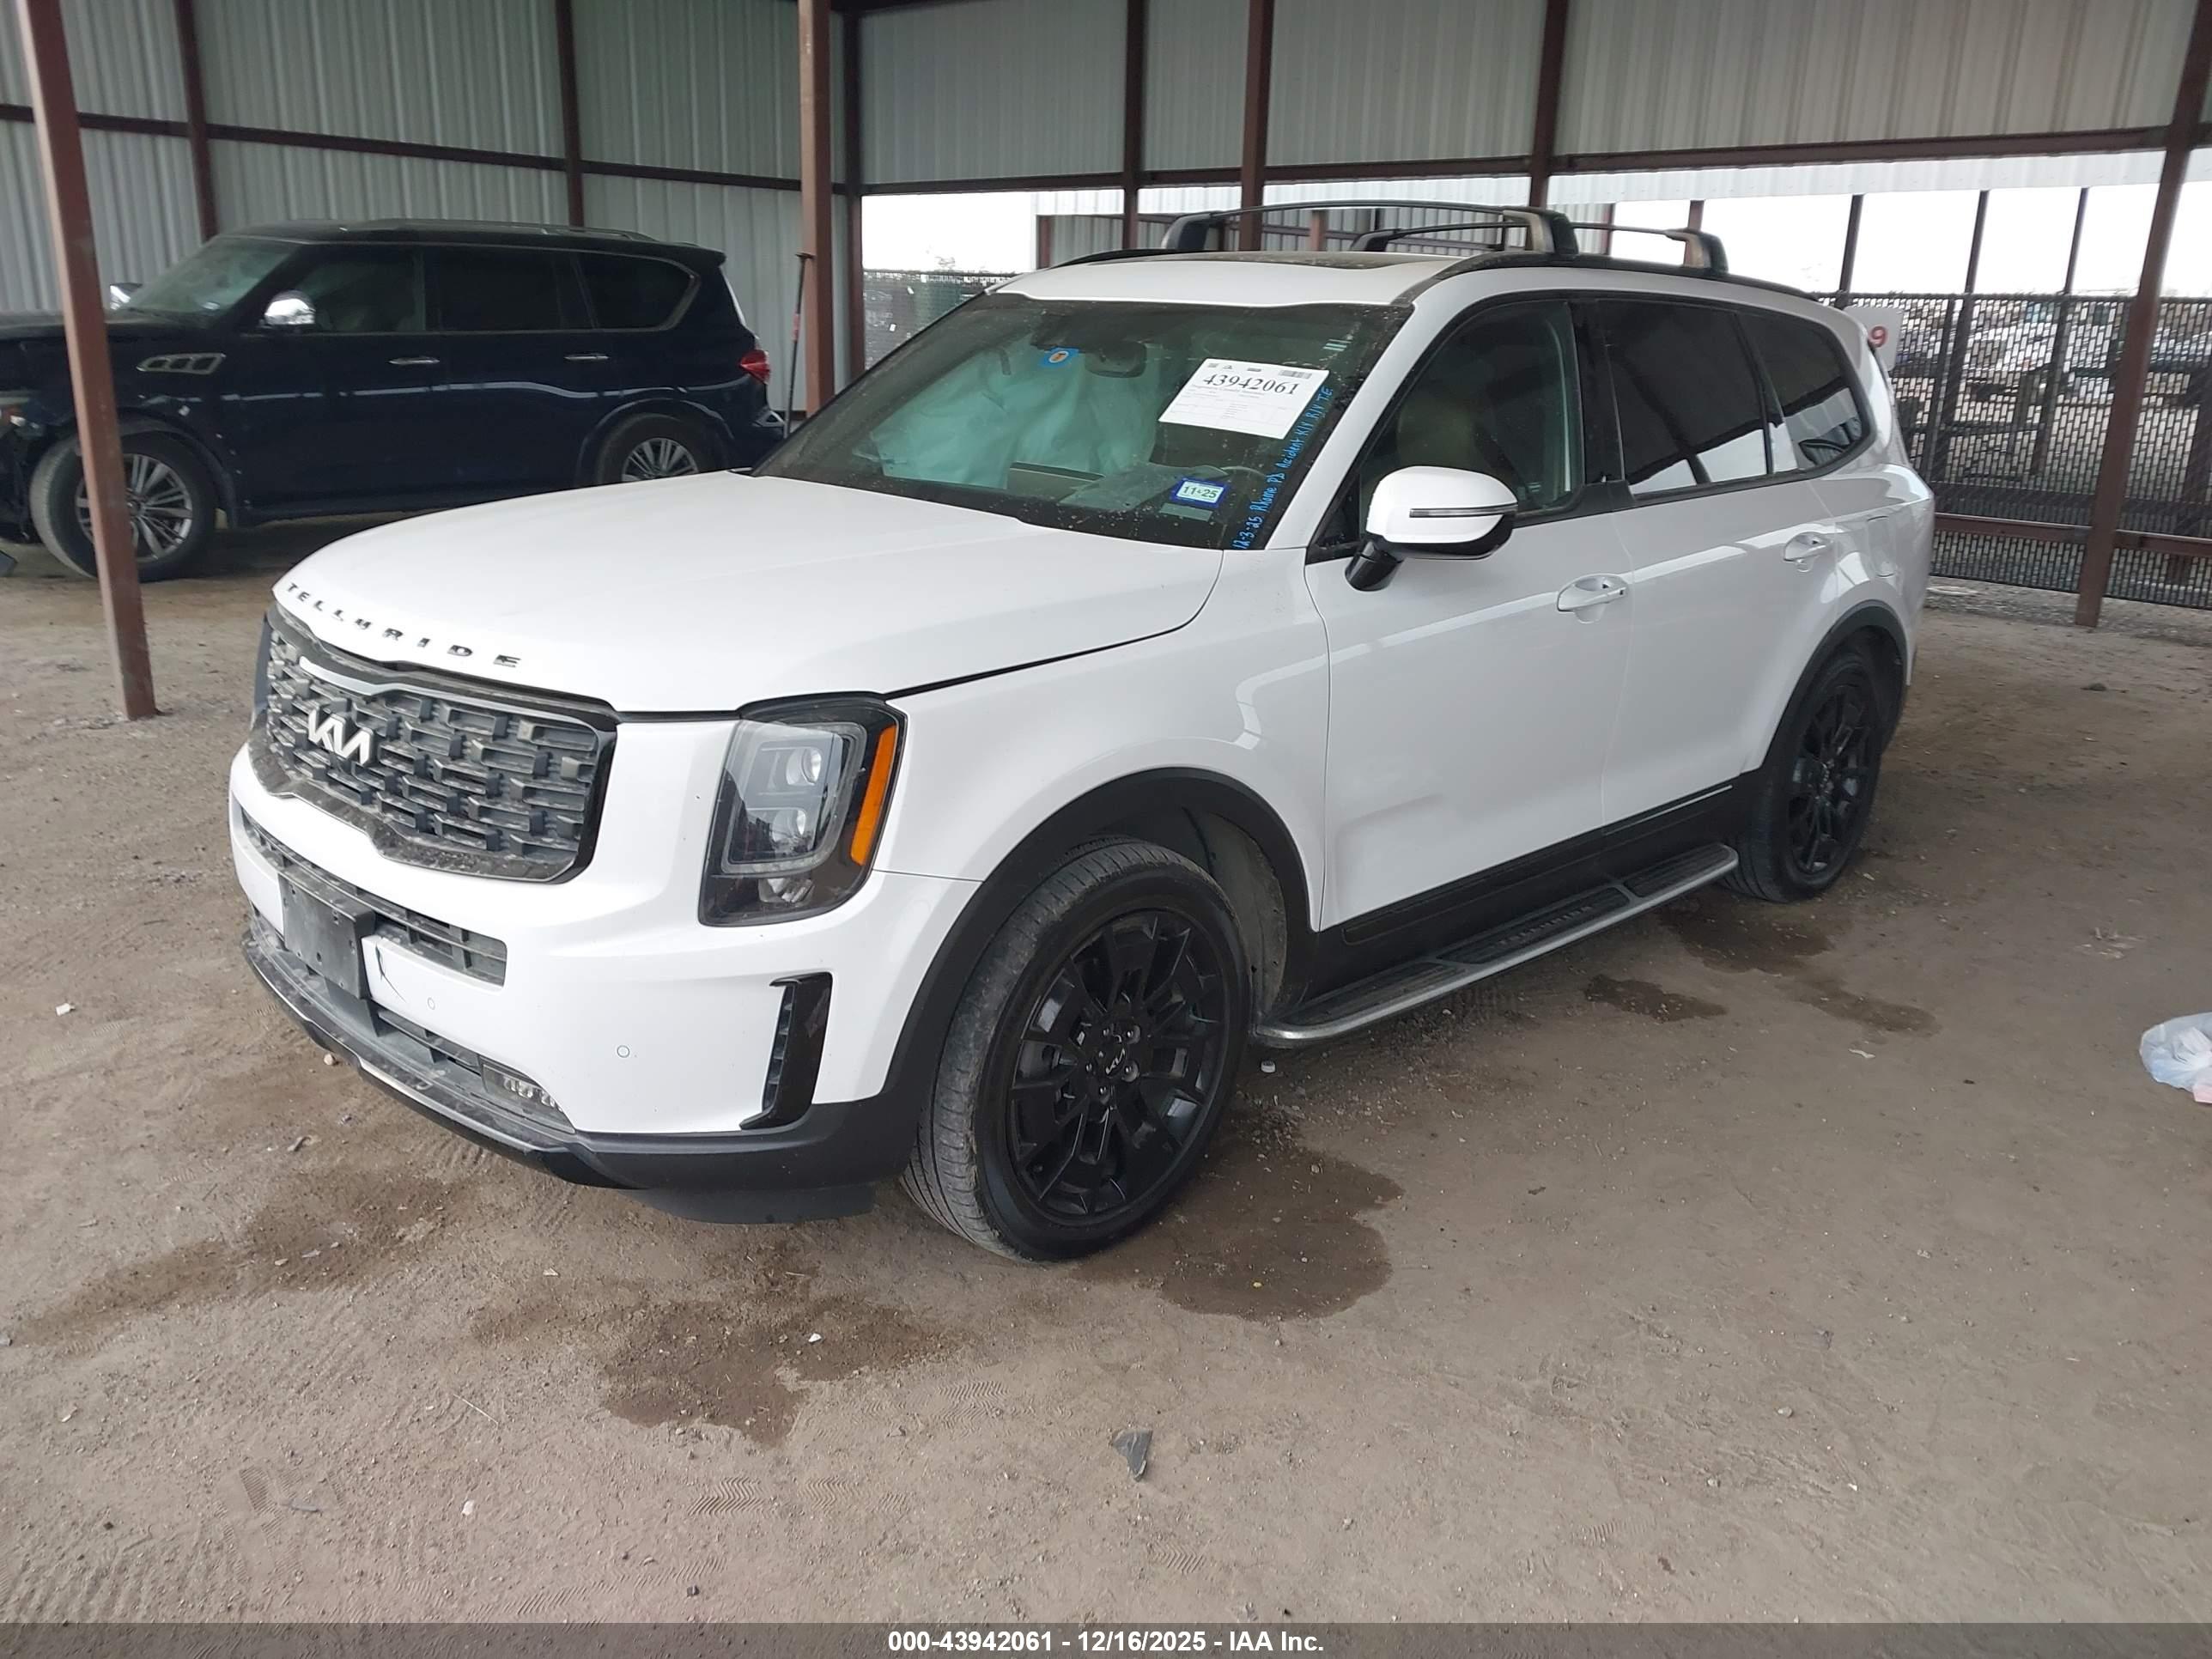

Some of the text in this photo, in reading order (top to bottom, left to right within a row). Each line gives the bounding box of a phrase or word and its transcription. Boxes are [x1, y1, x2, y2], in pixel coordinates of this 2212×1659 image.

[1203, 374, 1299, 395] 43942061
[287, 582, 521, 668] TELLURIDE
[308, 702, 374, 765] KIA
